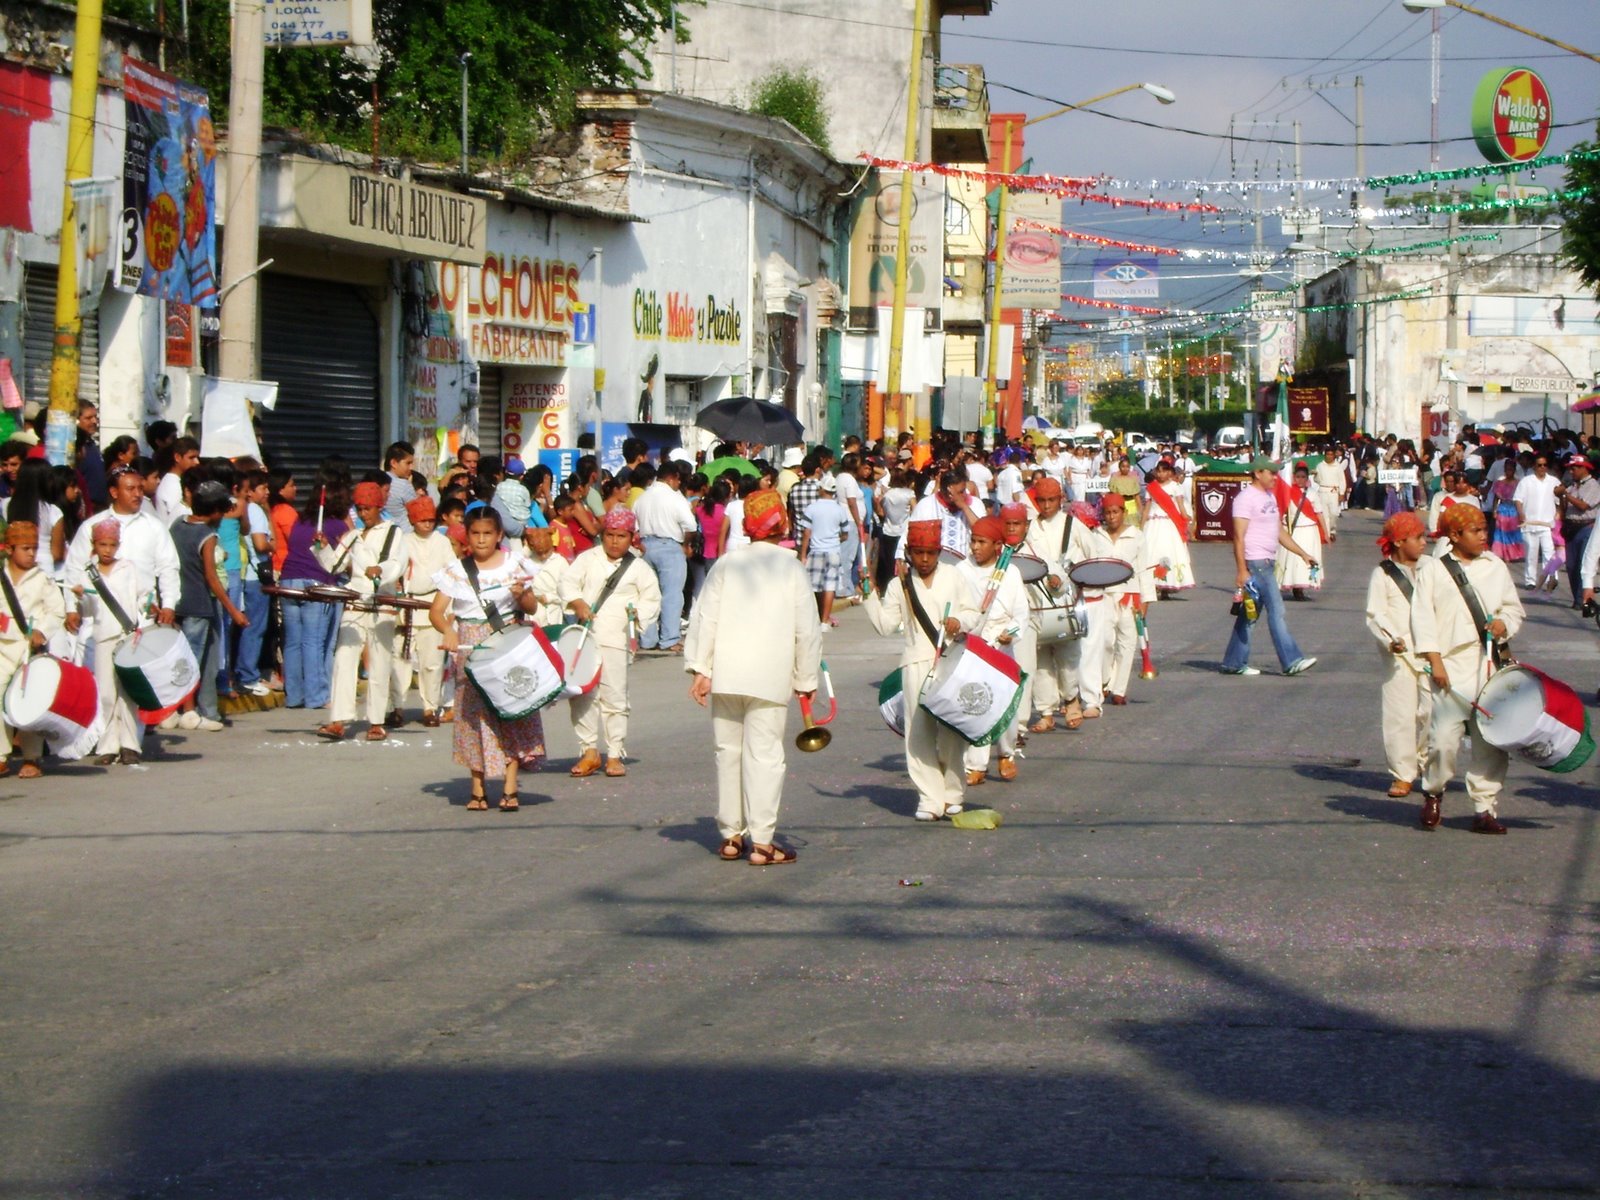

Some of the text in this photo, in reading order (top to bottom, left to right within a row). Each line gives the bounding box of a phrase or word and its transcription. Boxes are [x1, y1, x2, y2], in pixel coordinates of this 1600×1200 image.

[275, 7, 320, 15] LOCAL
[1498, 95, 1547, 121] Waldo's
[1508, 119, 1539, 139] MART
[349, 175, 475, 249] OPTICA ABUNDEZ
[867, 243, 928, 253] moros
[1115, 265, 1138, 281] SR
[429, 255, 579, 326] OLCHONES
[633, 287, 663, 336] Chile
[667, 291, 694, 338] Mole
[707, 294, 741, 341] Pozole
[513, 383, 565, 396] EXTENSO
[1515, 378, 1575, 391] OBRAS PUBLICAS
[508, 397, 556, 409] SURTIDO
[1095, 481, 1108, 489] LIBE
